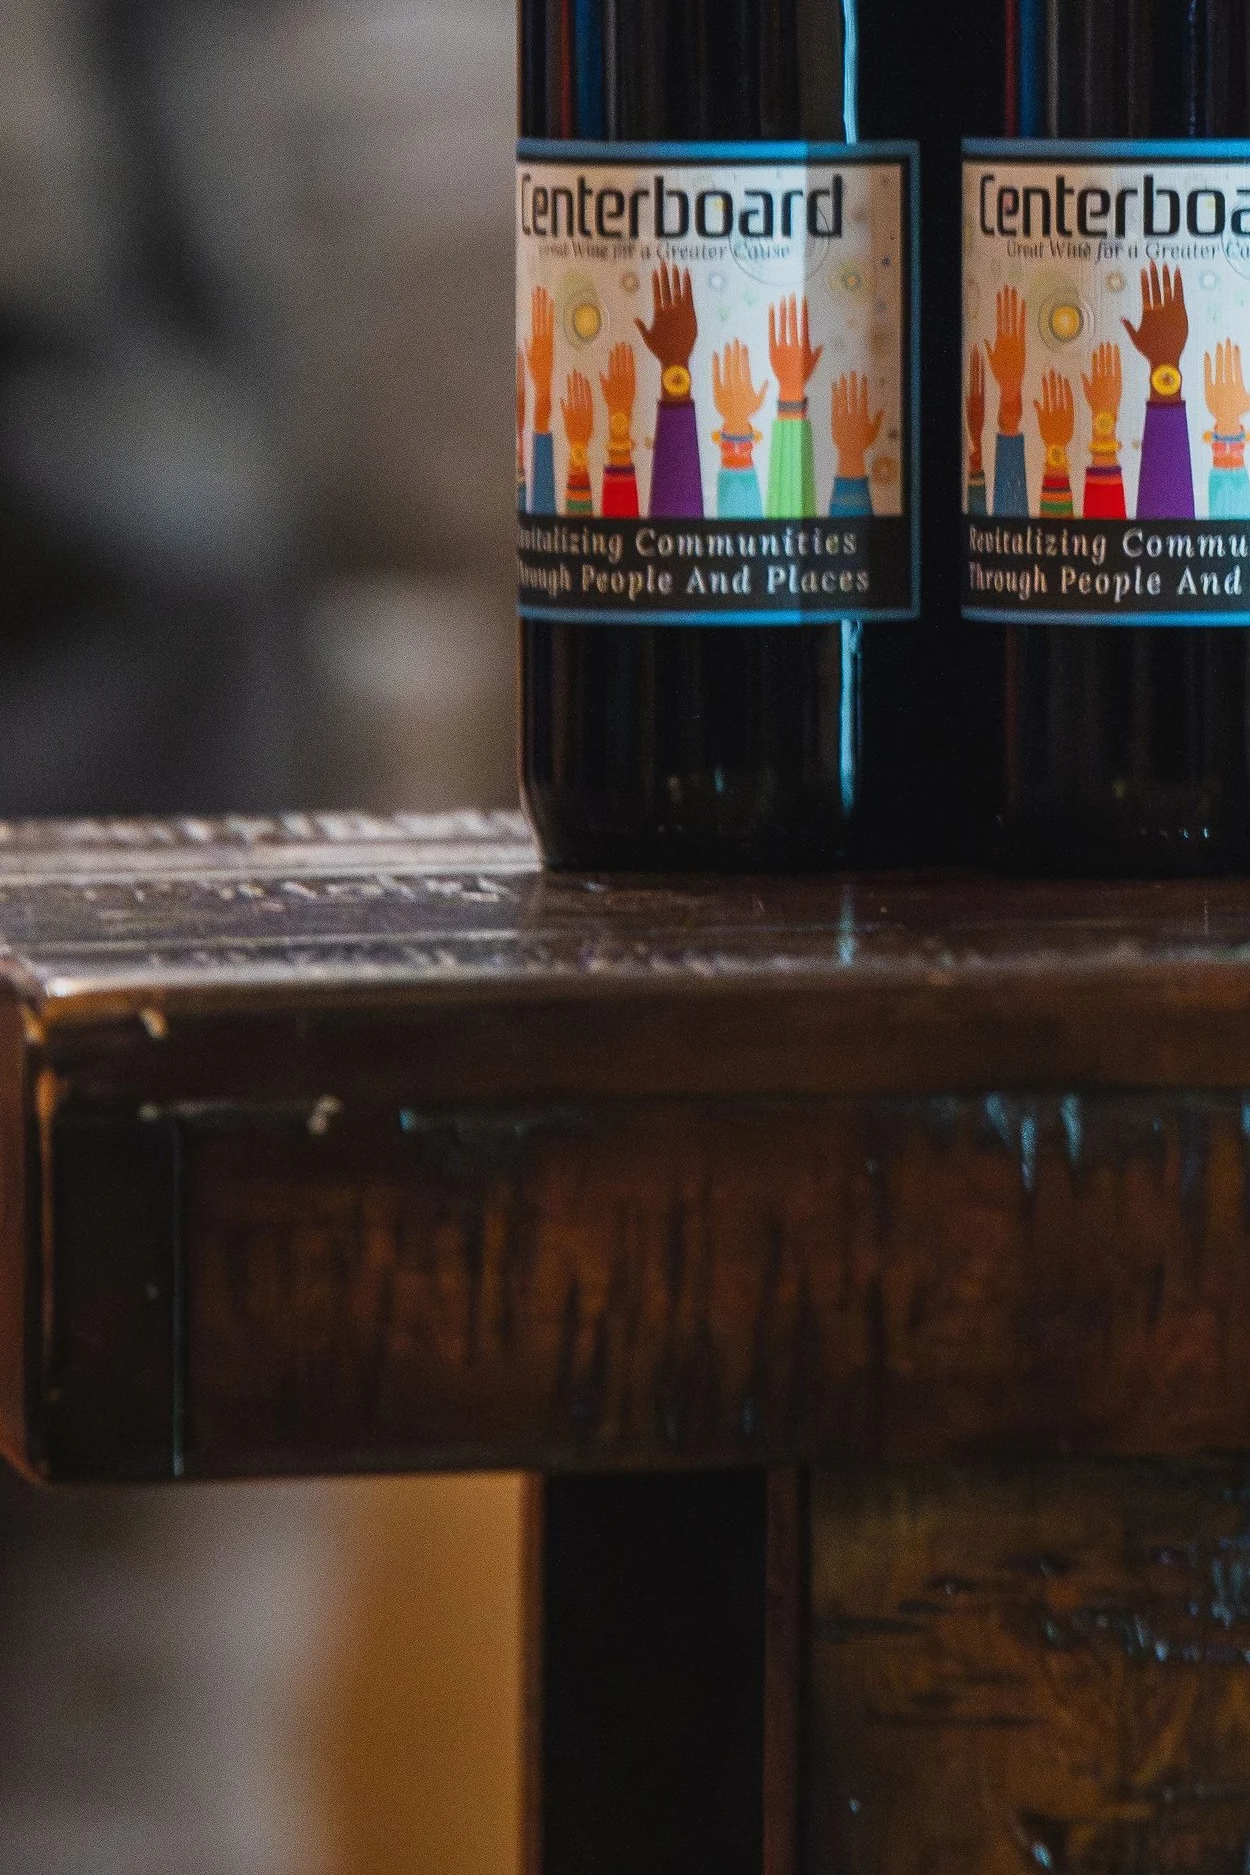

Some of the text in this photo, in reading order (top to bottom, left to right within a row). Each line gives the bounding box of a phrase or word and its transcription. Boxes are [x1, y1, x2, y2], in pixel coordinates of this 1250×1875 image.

[521, 171, 844, 240] Centerboard
[733, 241, 791, 260] Cause
[1050, 239, 1091, 258] Wine
[1096, 239, 1124, 263] for
[1128, 243, 1139, 259] a
[1145, 239, 1219, 260] Greater
[636, 526, 857, 558] Communities
[970, 525, 1107, 565] Revitalizing
[582, 564, 673, 602] People
[686, 563, 750, 595] And
[767, 563, 870, 594] Places
[969, 562, 1048, 601] Through
[1061, 565, 1160, 603] People
[1177, 565, 1243, 596] And
